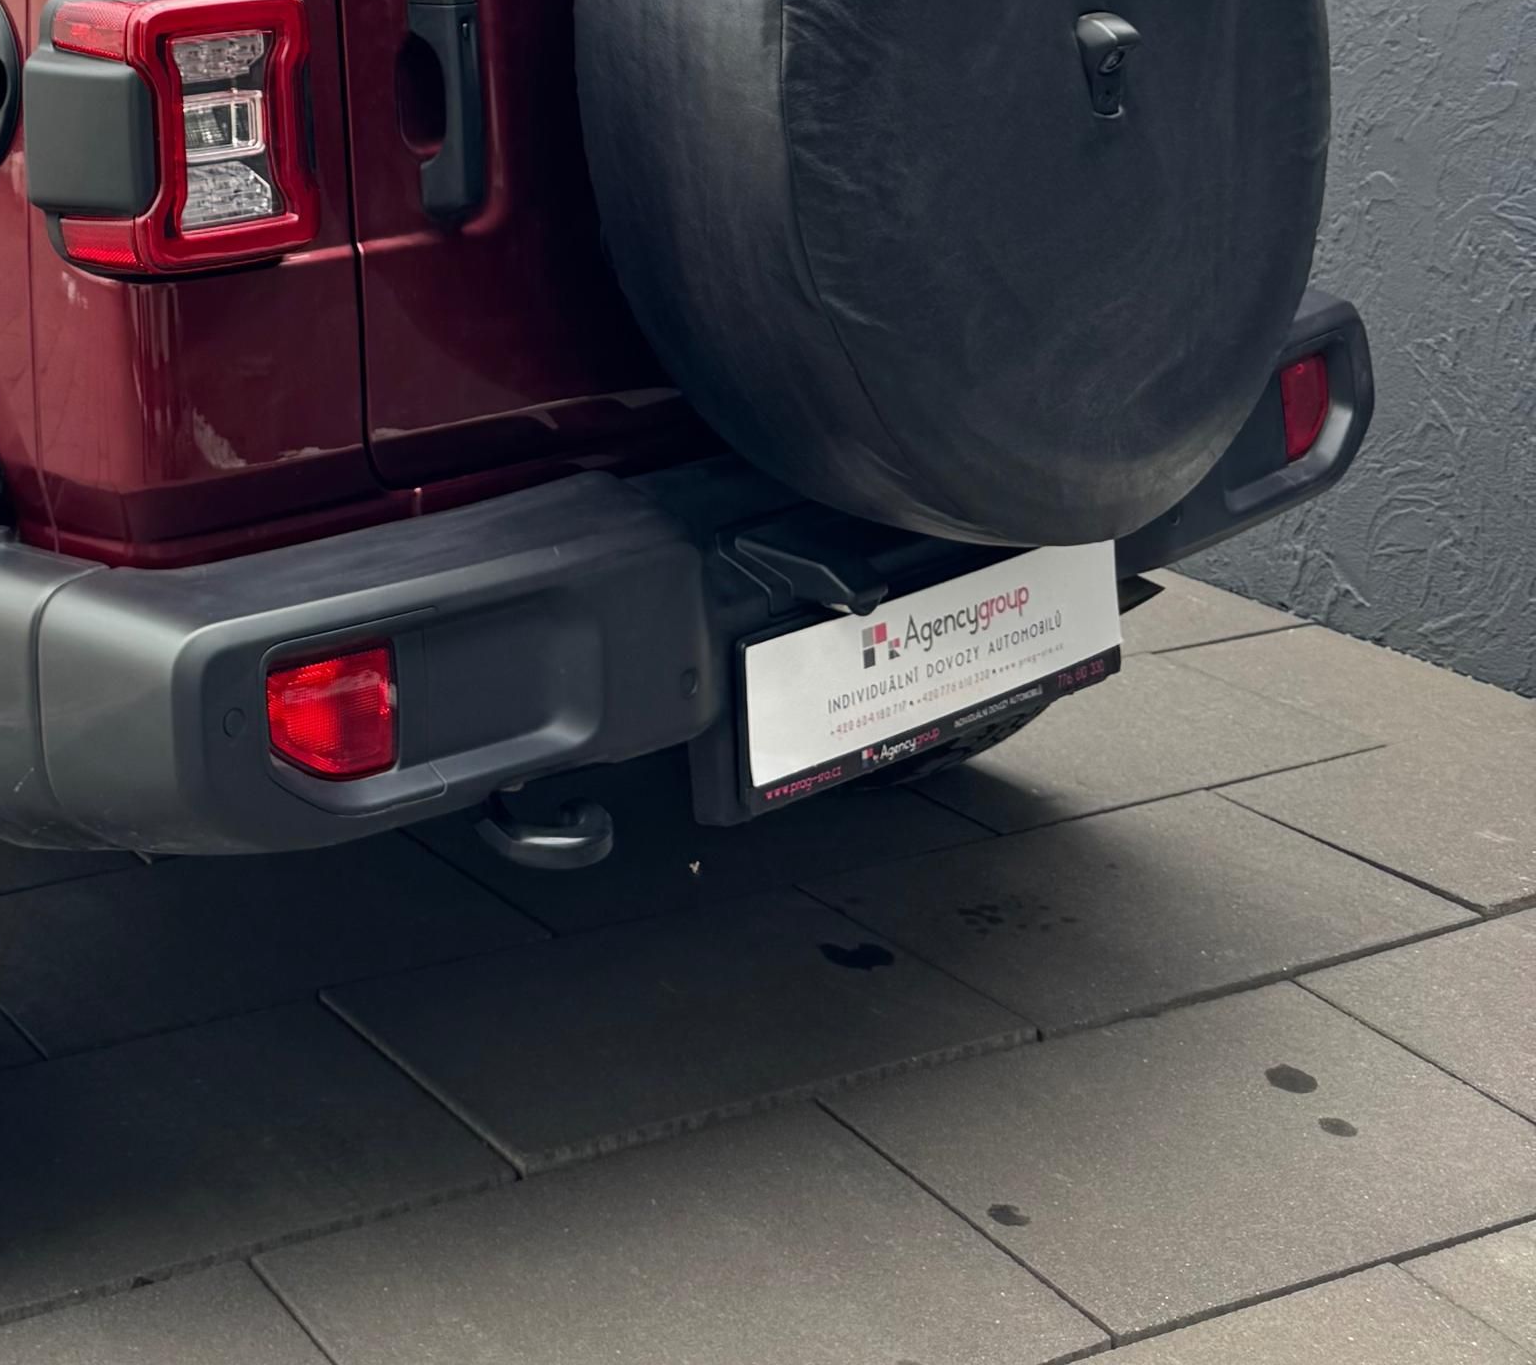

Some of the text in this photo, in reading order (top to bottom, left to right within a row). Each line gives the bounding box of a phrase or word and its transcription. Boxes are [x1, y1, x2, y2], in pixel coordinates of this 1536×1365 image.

[904, 586, 1030, 652] Agencygroup
[828, 609, 1063, 715] INDIVIDUÁLNÍ DOVOZY AUTOMOBILŮ
[880, 727, 941, 761] Agencygroup
